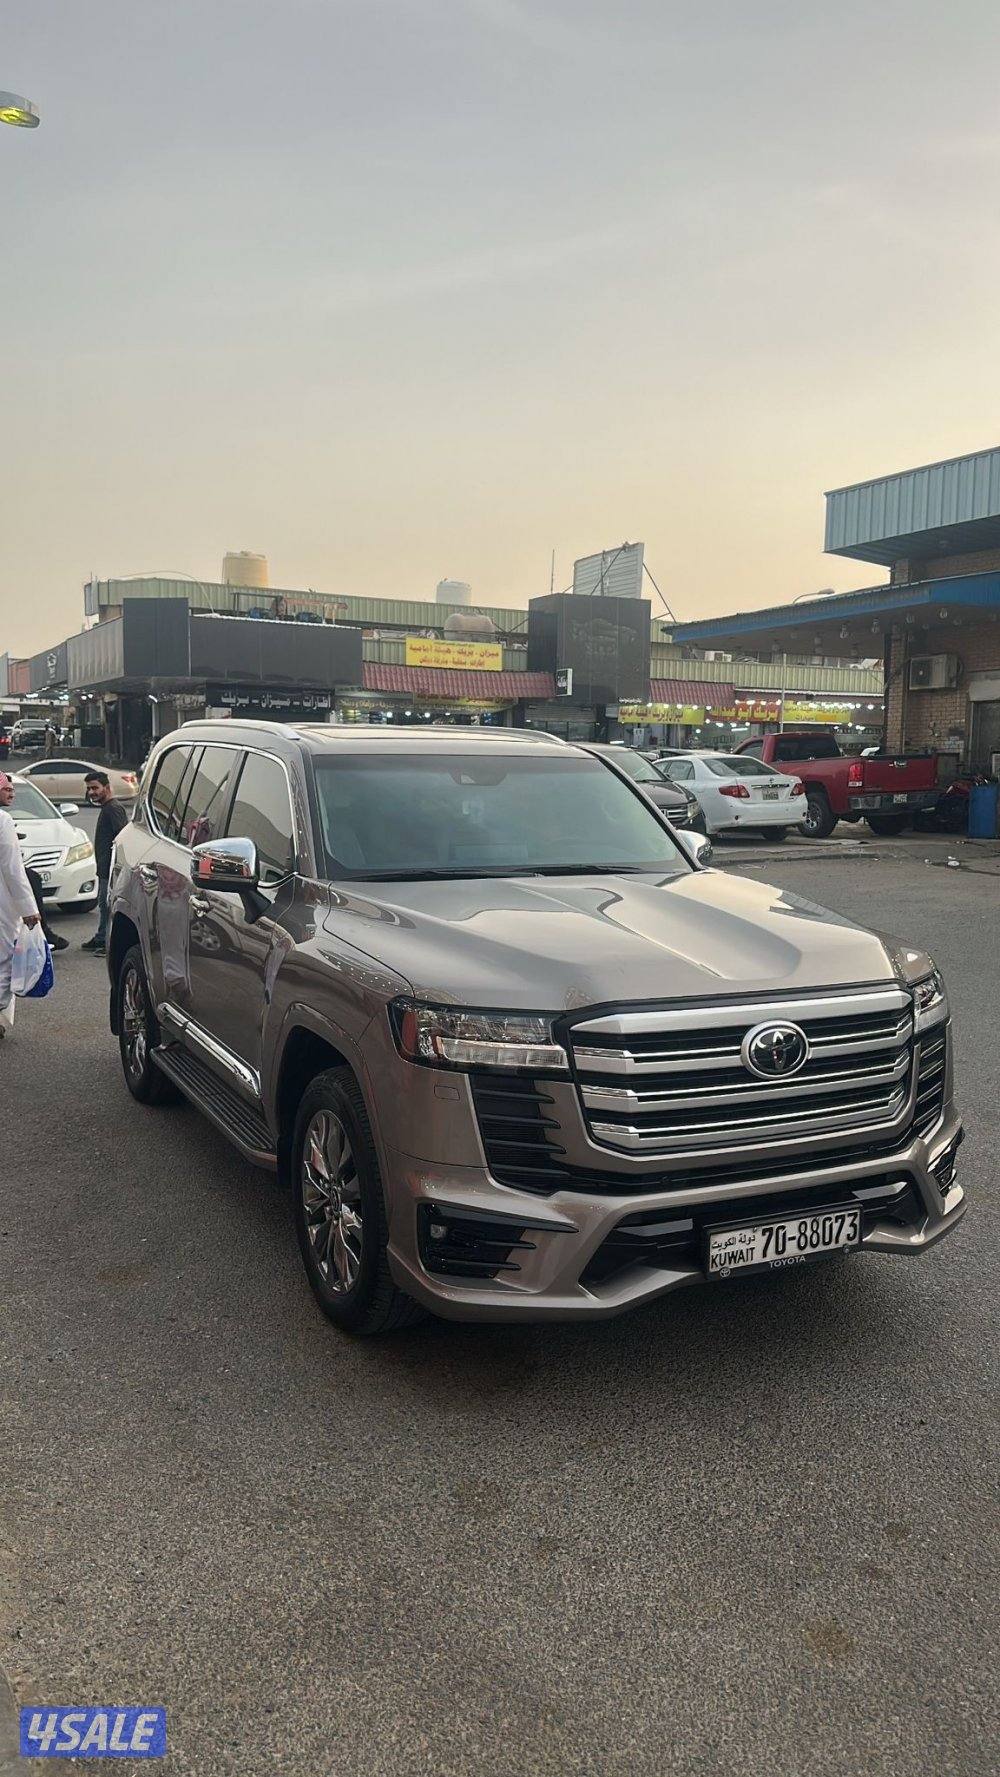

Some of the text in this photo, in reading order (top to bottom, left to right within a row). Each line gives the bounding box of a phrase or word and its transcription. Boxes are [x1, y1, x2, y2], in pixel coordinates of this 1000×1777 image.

[261, 691, 291, 709] ميزان
[711, 1233, 756, 1251] دولة الكويت
[761, 1212, 859, 1259] 70-88073
[710, 1246, 756, 1269] KUWAIT
[769, 1255, 807, 1269] TOYOTA
